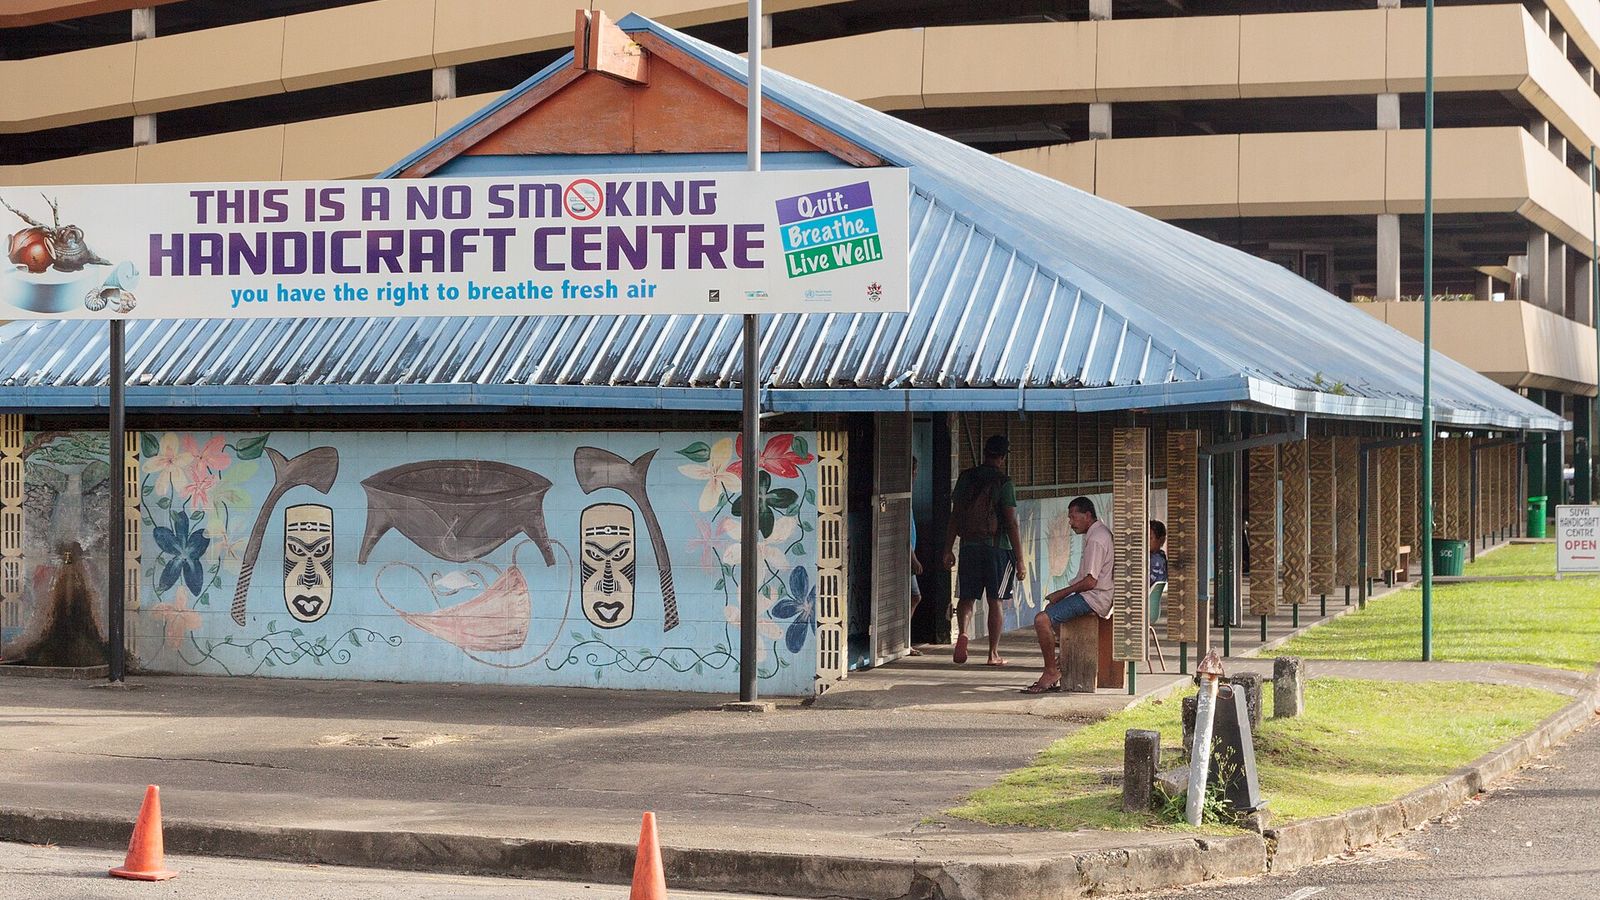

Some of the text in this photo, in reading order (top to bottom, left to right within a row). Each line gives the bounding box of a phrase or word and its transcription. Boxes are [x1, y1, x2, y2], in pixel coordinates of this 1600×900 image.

[190, 189, 288, 224] THIS
[305, 188, 345, 222] IS
[361, 187, 390, 221] A
[406, 185, 472, 221] NO
[797, 191, 849, 218] Quit.
[788, 215, 870, 248] Breathe.
[149, 224, 765, 276] HANDICRAFT CENTRE
[788, 238, 881, 276] Live Well.
[231, 278, 657, 308] you have the right to breathe fresh air
[1570, 508, 1590, 517] SUVA
[1564, 540, 1597, 551] OPEN
[1566, 528, 1595, 537] CENTRE
